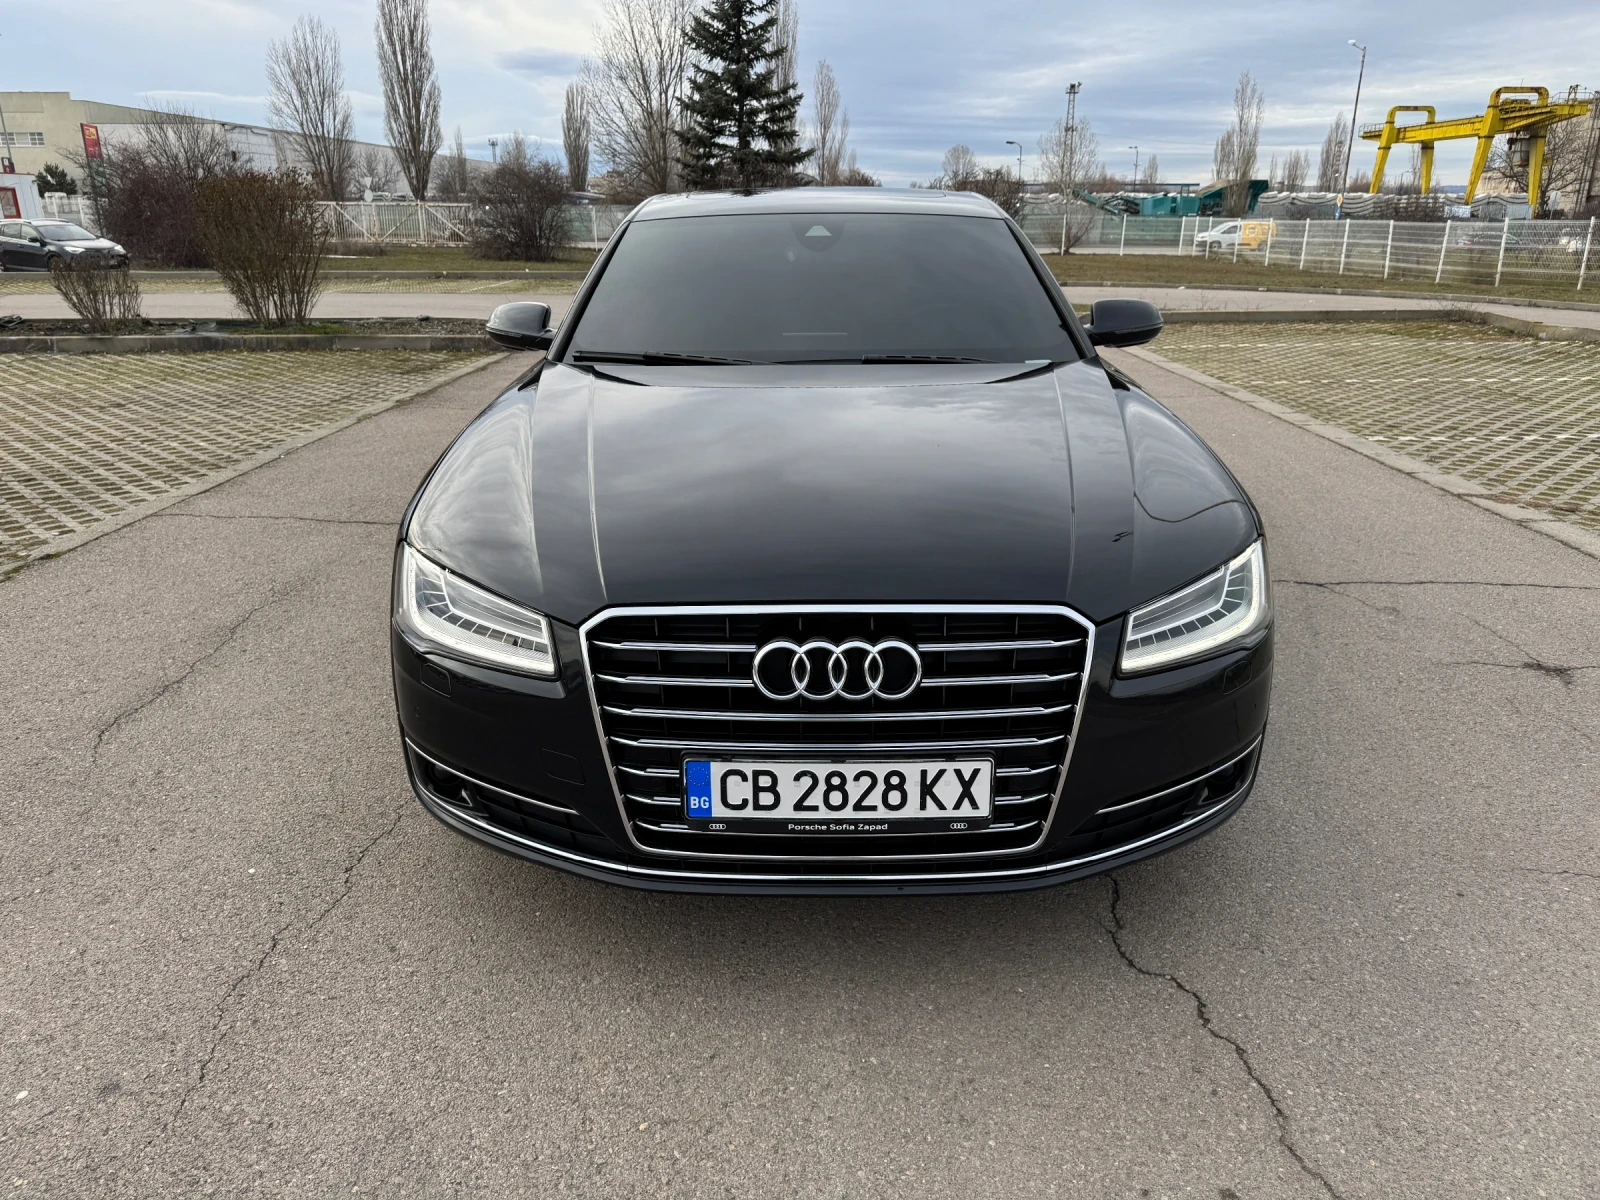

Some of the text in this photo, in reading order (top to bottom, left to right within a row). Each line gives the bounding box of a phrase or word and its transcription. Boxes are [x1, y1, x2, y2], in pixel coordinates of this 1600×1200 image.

[720, 768, 981, 812] CB 2828 KX
[690, 796, 710, 809] BG
[788, 823, 888, 832] Porsche Sofia Zapad
